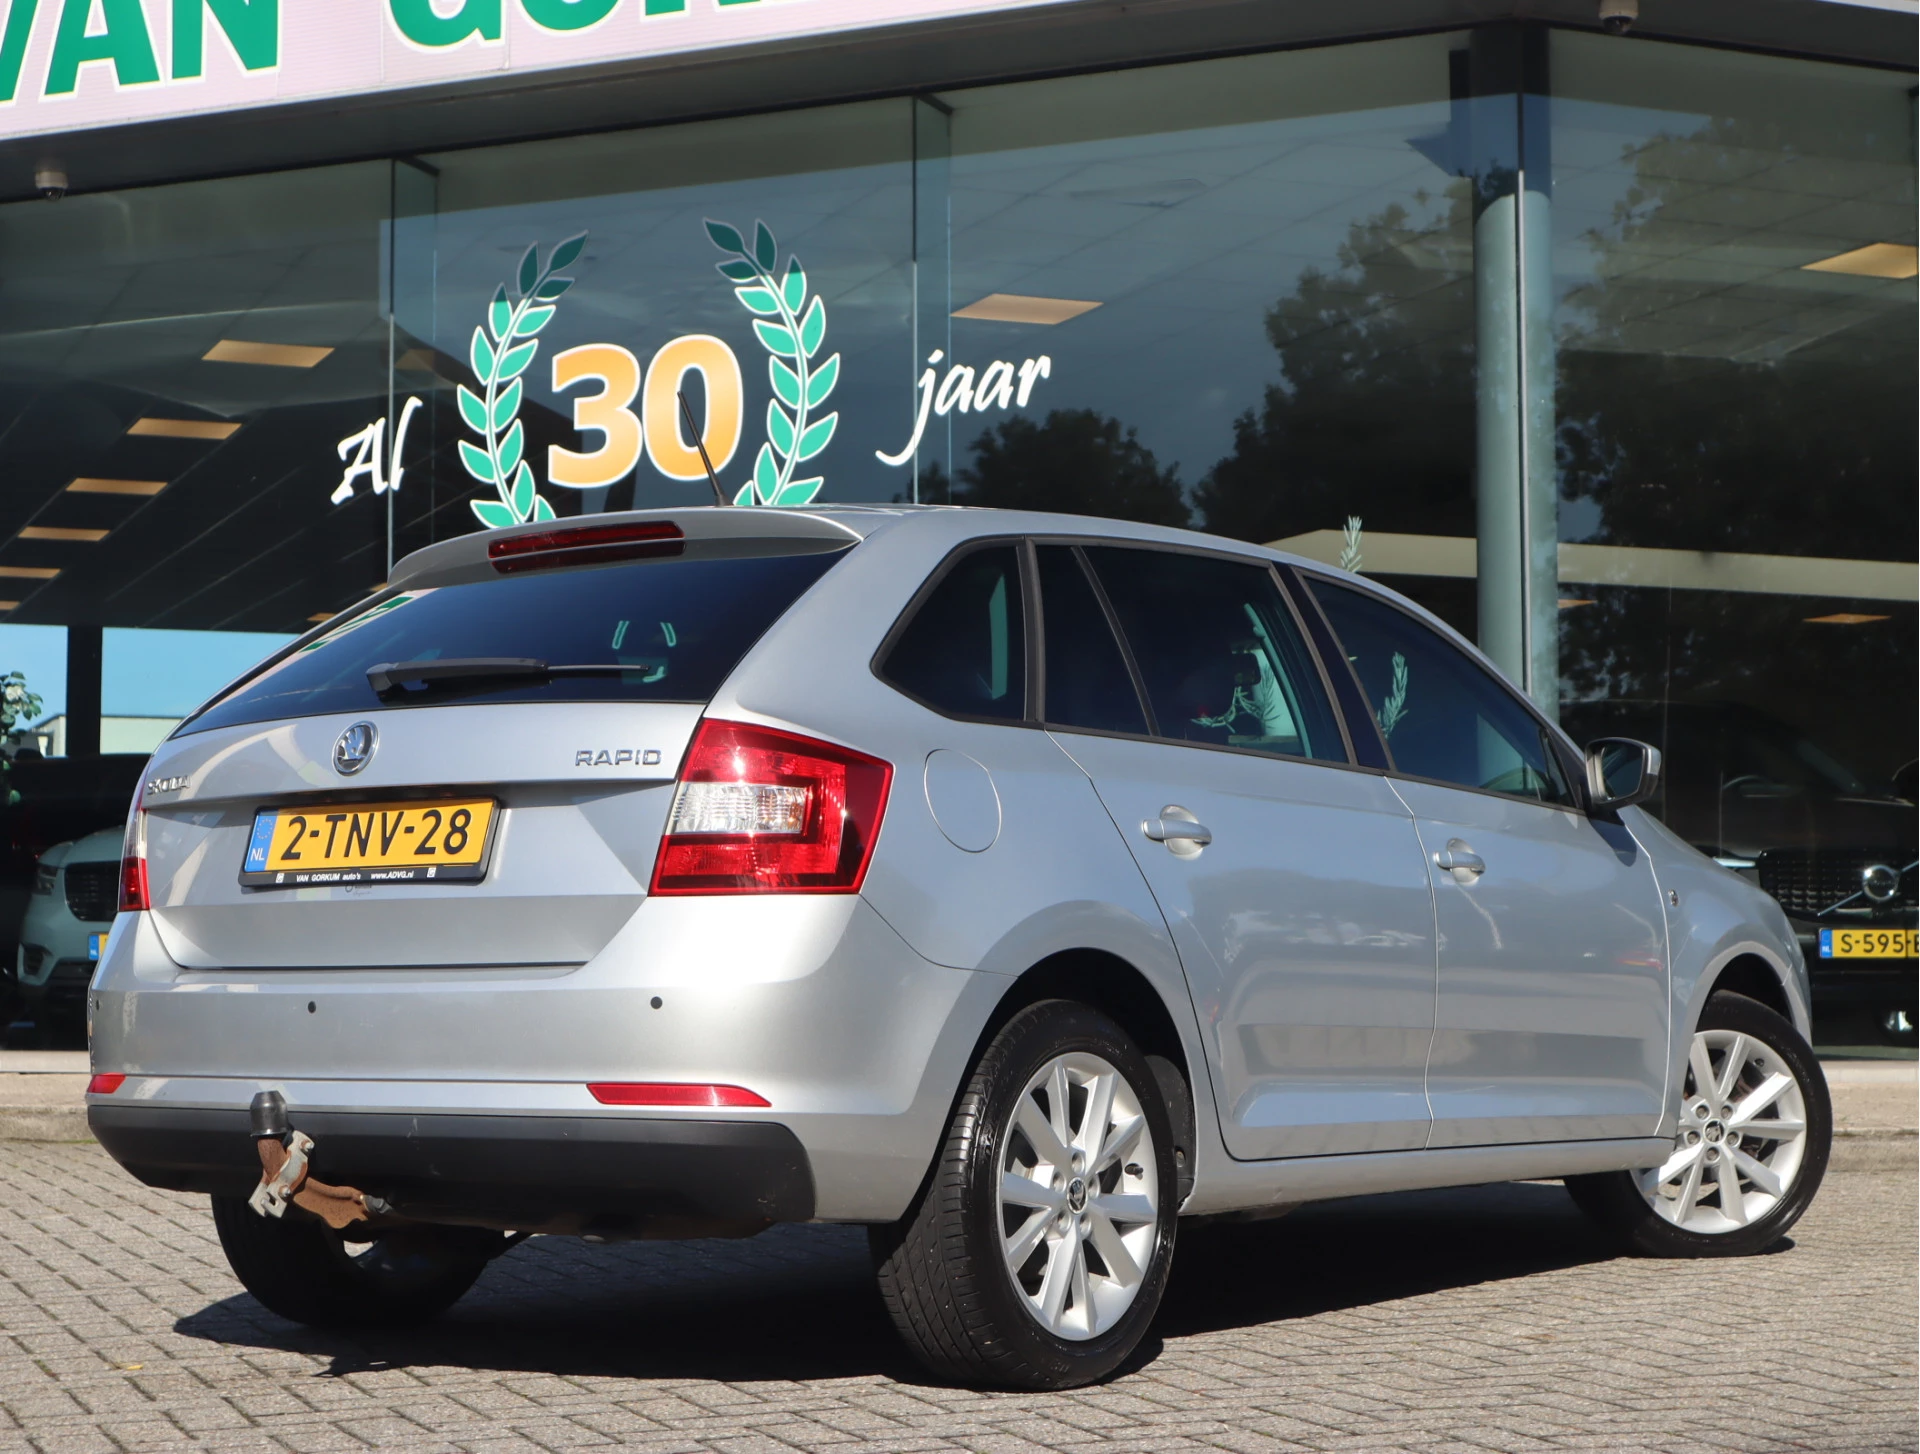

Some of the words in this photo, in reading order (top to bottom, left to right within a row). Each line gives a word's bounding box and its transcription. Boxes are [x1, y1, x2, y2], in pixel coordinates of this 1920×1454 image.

[330, 396, 422, 505] Al
[548, 334, 744, 488] 30
[875, 348, 1051, 466] jaar
[575, 749, 662, 767] RAPID
[280, 808, 472, 861] 2-TNV-28
[250, 847, 265, 862] NL
[296, 874, 310, 882] VAN
[311, 873, 341, 882] GORKUM
[342, 872, 362, 881] auto's
